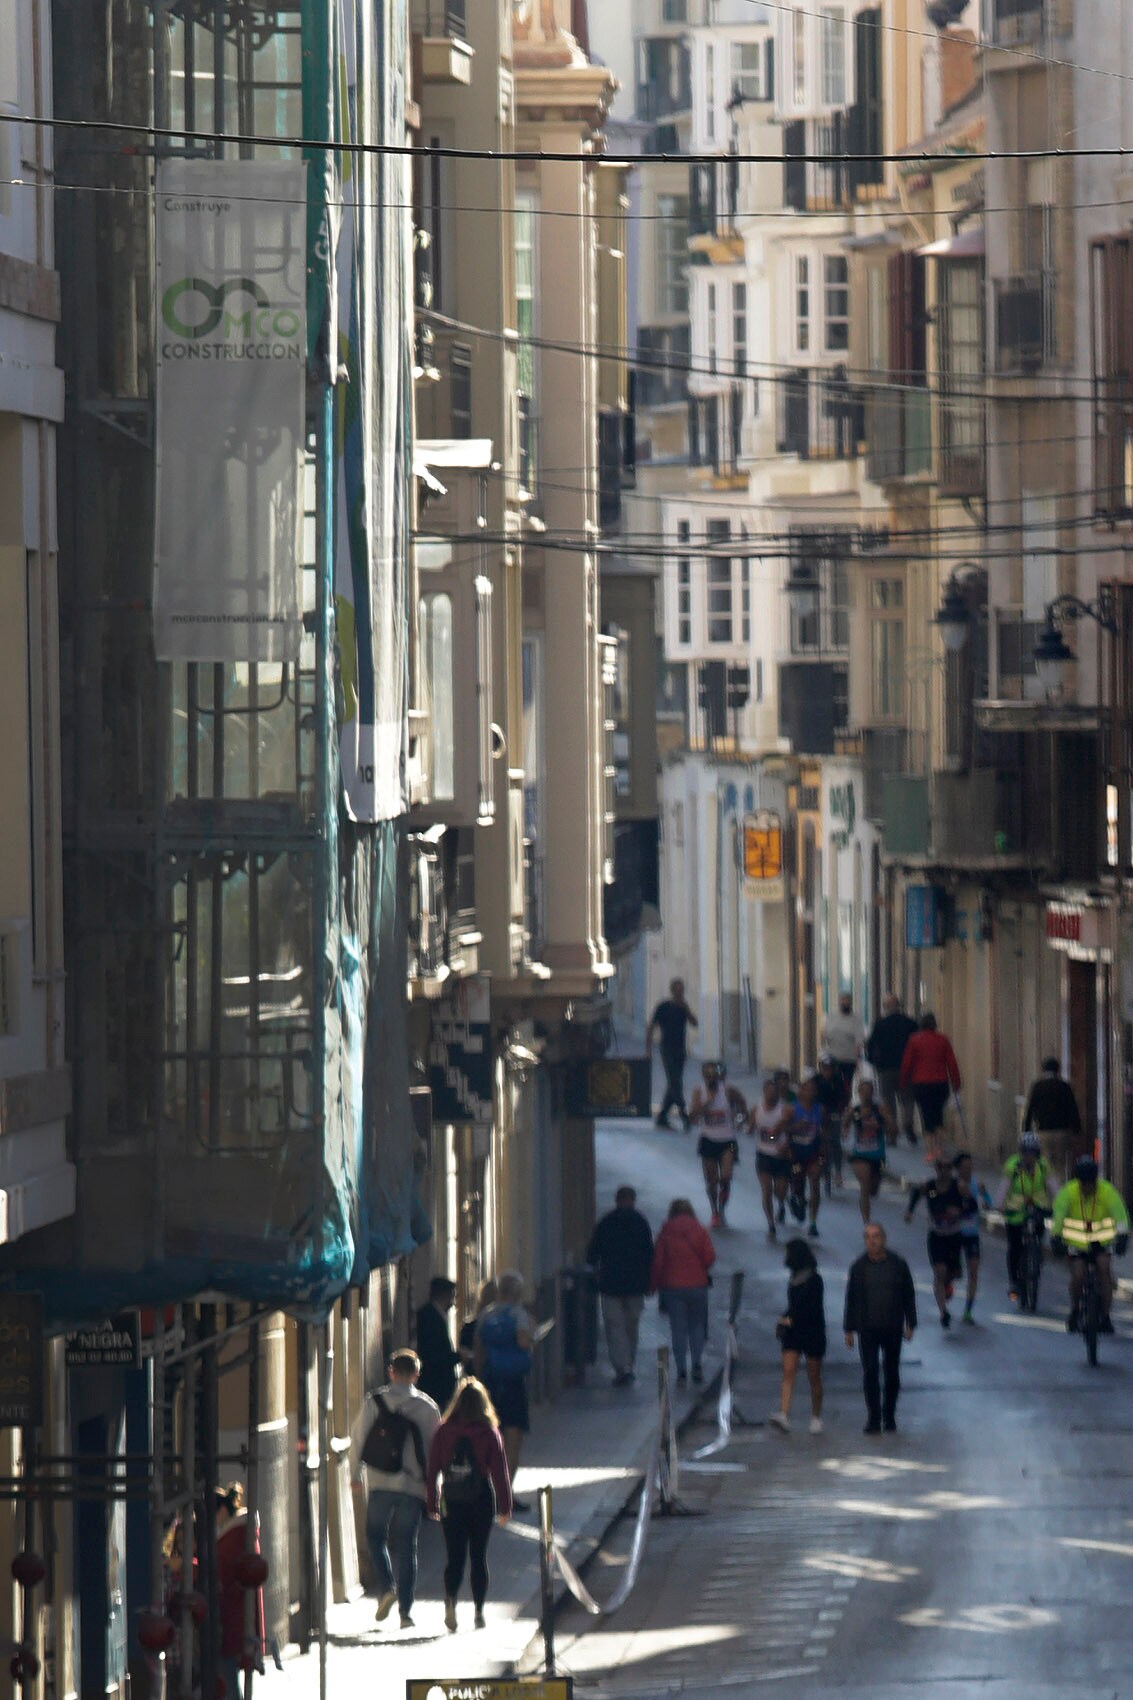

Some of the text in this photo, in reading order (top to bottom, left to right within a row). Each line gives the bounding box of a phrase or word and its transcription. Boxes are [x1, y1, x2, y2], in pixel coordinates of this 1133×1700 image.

[164, 199, 231, 216] Construye
[162, 344, 300, 360] CONSTRUCCION
[80, 1331, 133, 1348] NEGRA
